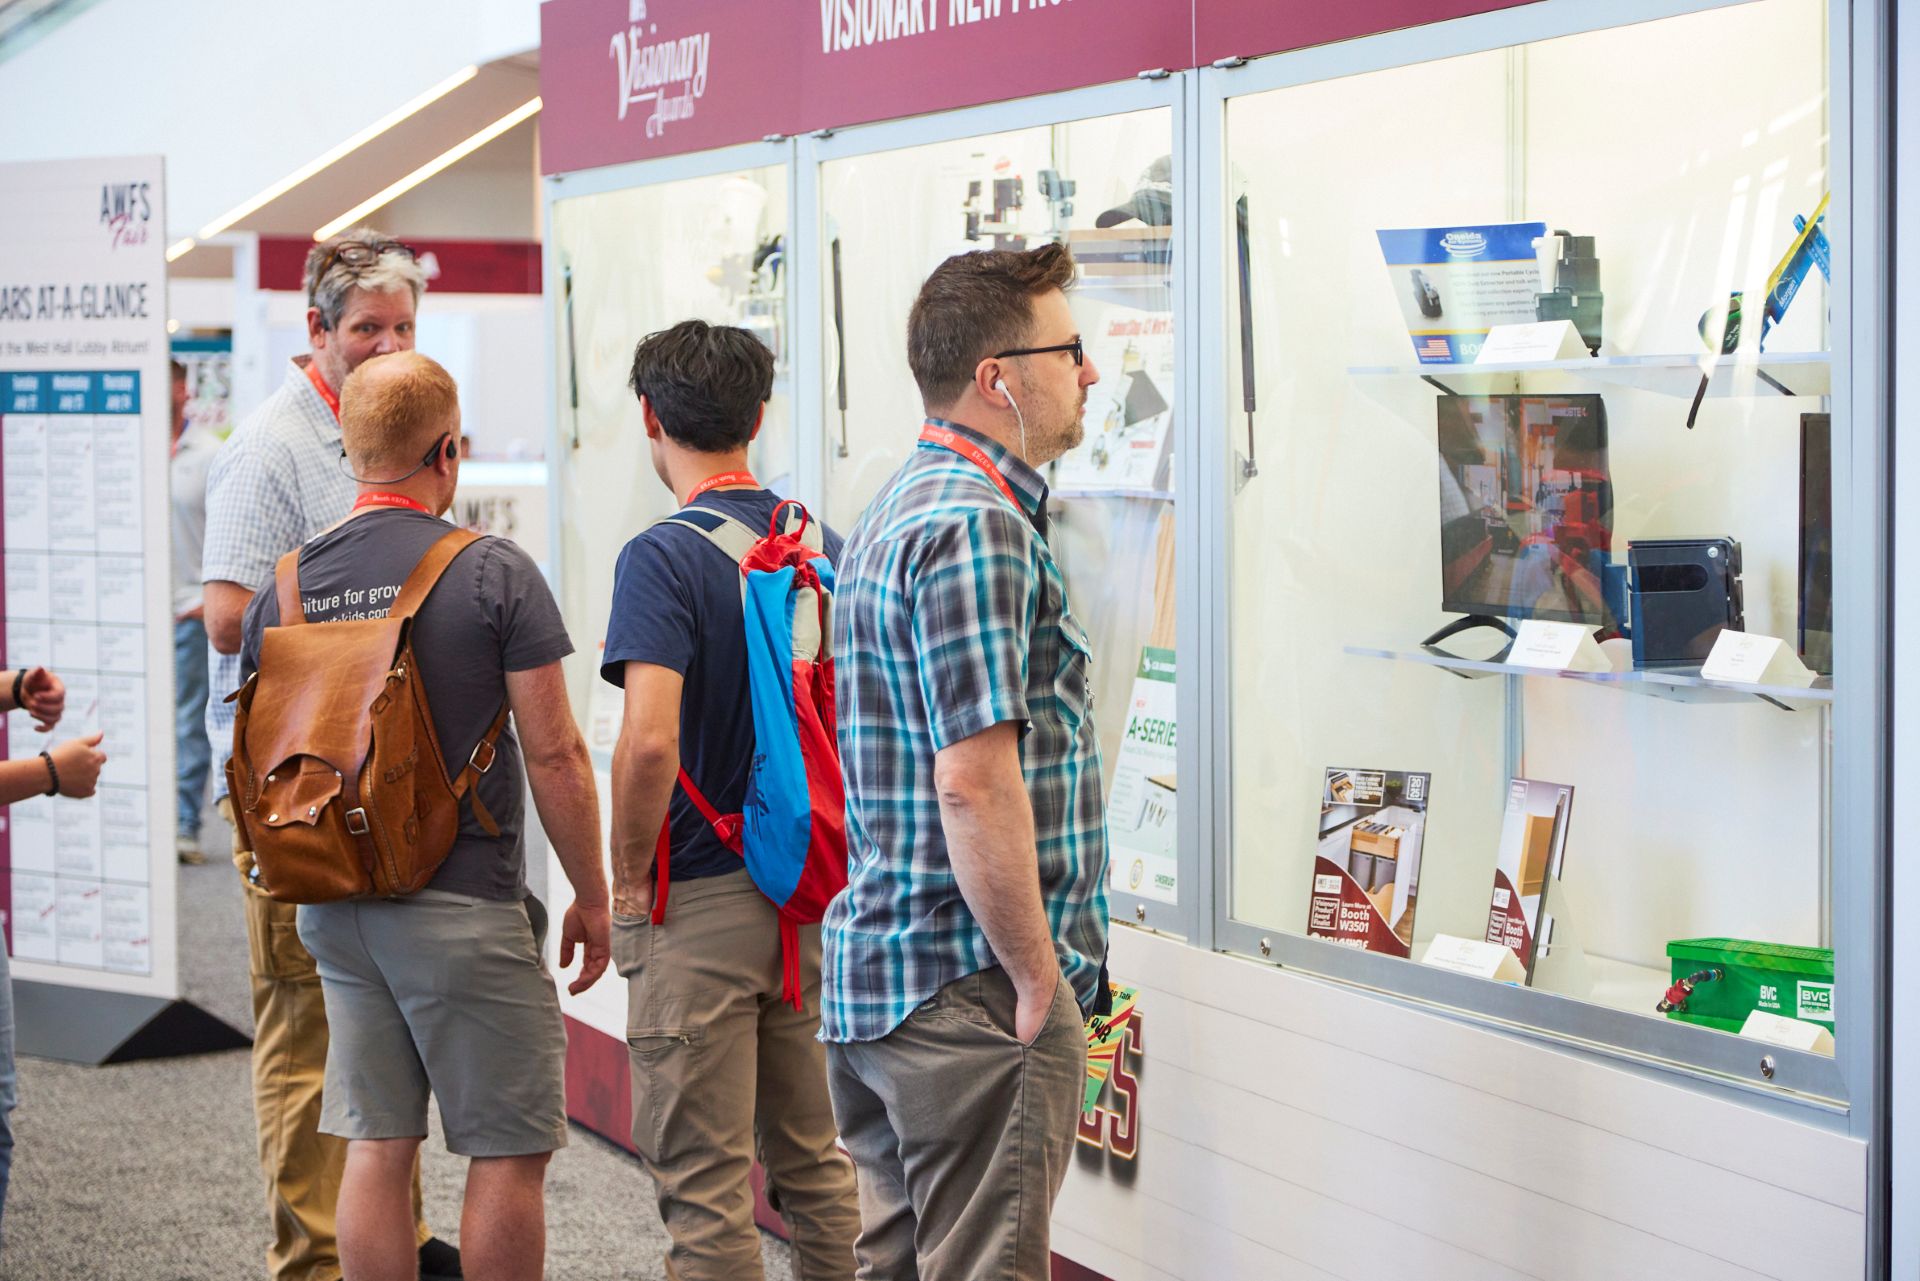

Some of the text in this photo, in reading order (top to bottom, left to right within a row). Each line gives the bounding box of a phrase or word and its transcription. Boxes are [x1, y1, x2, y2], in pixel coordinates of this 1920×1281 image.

[609, 24, 710, 120] Visionary
[100, 182, 151, 223] AWFS
[37, 283, 149, 320] AT-A-GLANCE
[26, 341, 48, 354] West
[344, 589, 365, 606] for
[1411, 777, 1421, 788] 20
[1410, 788, 1420, 798] 25
[1341, 907, 1370, 921] Booth
[1340, 919, 1370, 933] W3501
[1506, 922, 1524, 936] Booth
[1119, 991, 1132, 1002] Talk
[1760, 985, 1777, 1000] BVC
[1802, 990, 1828, 1002] BVC
